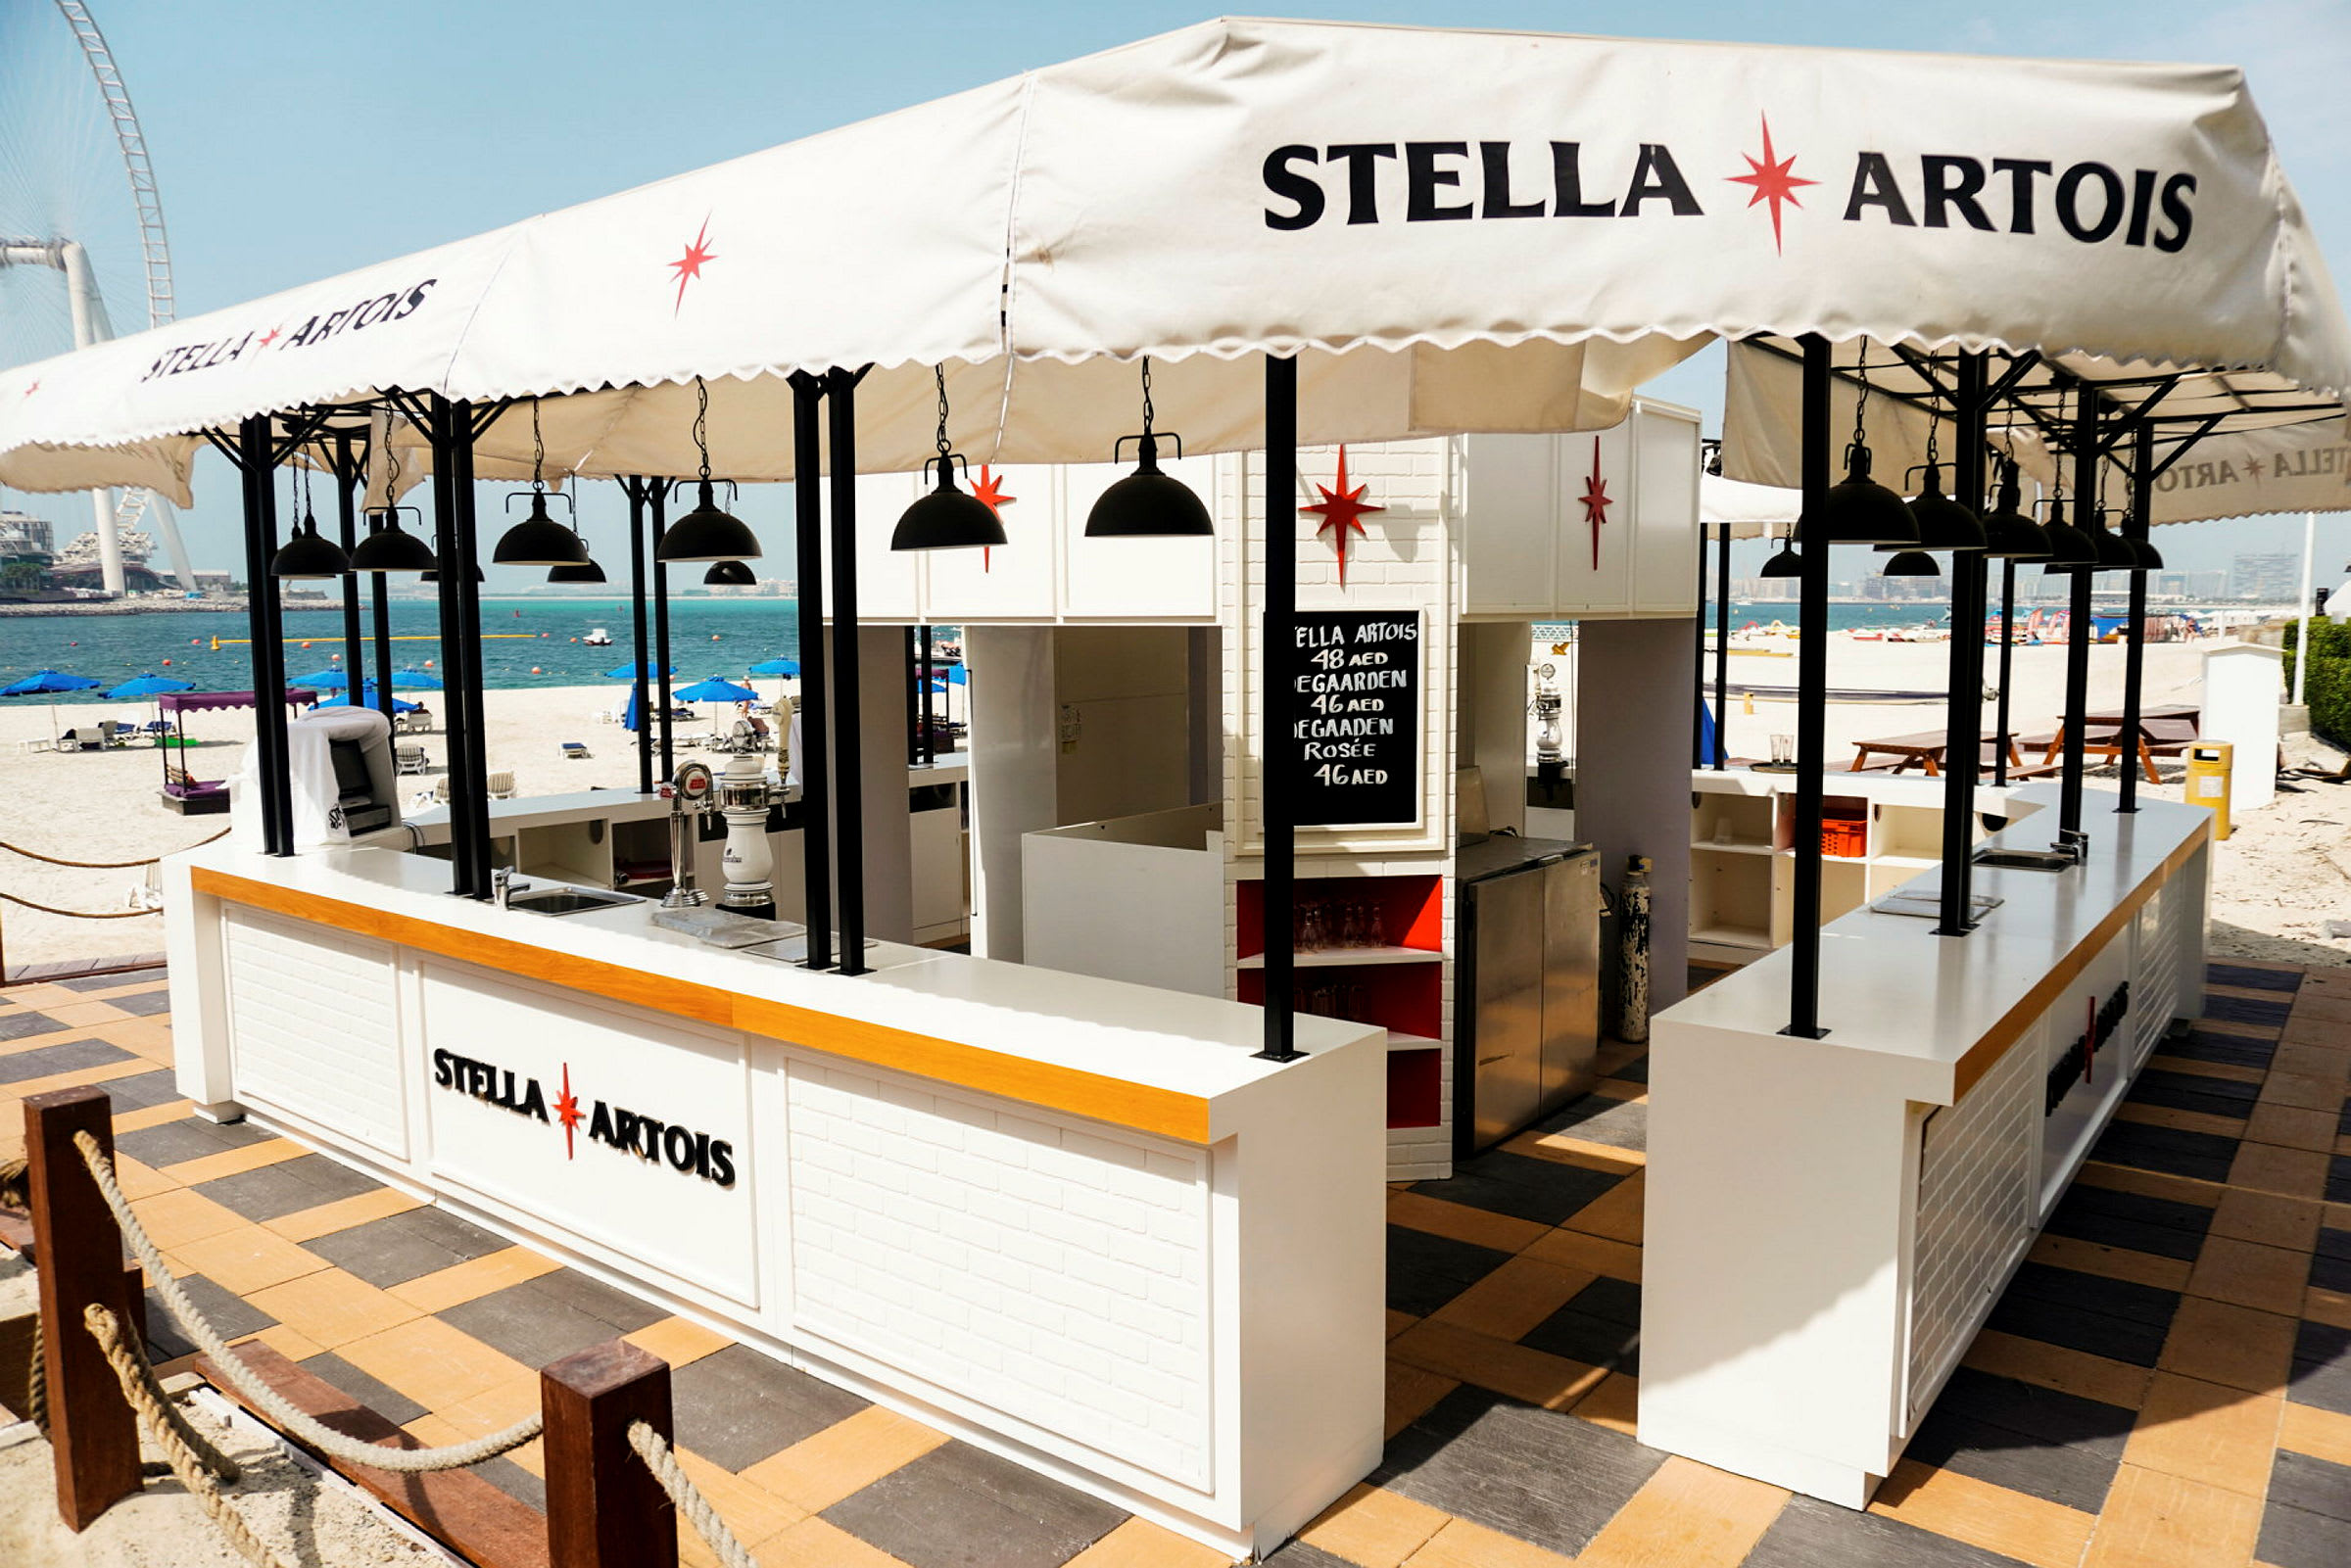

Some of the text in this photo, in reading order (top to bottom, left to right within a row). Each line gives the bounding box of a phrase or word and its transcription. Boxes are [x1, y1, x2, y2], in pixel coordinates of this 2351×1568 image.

[1262, 140, 2197, 255] STELLA ARTOIS
[141, 278, 438, 383] STELLA ARTOIS
[1295, 622, 1418, 648] ELLA ARTOIS
[1310, 648, 1389, 671] 48 AED
[1295, 670, 1408, 692] EGAARDEN
[1310, 693, 1385, 715] 46 AED
[1294, 718, 1394, 739] EGAADEN
[1304, 737, 1376, 761] ROSÉE
[1314, 764, 1388, 786] 46 AED
[434, 1048, 736, 1187] STELLA ARTOIS
